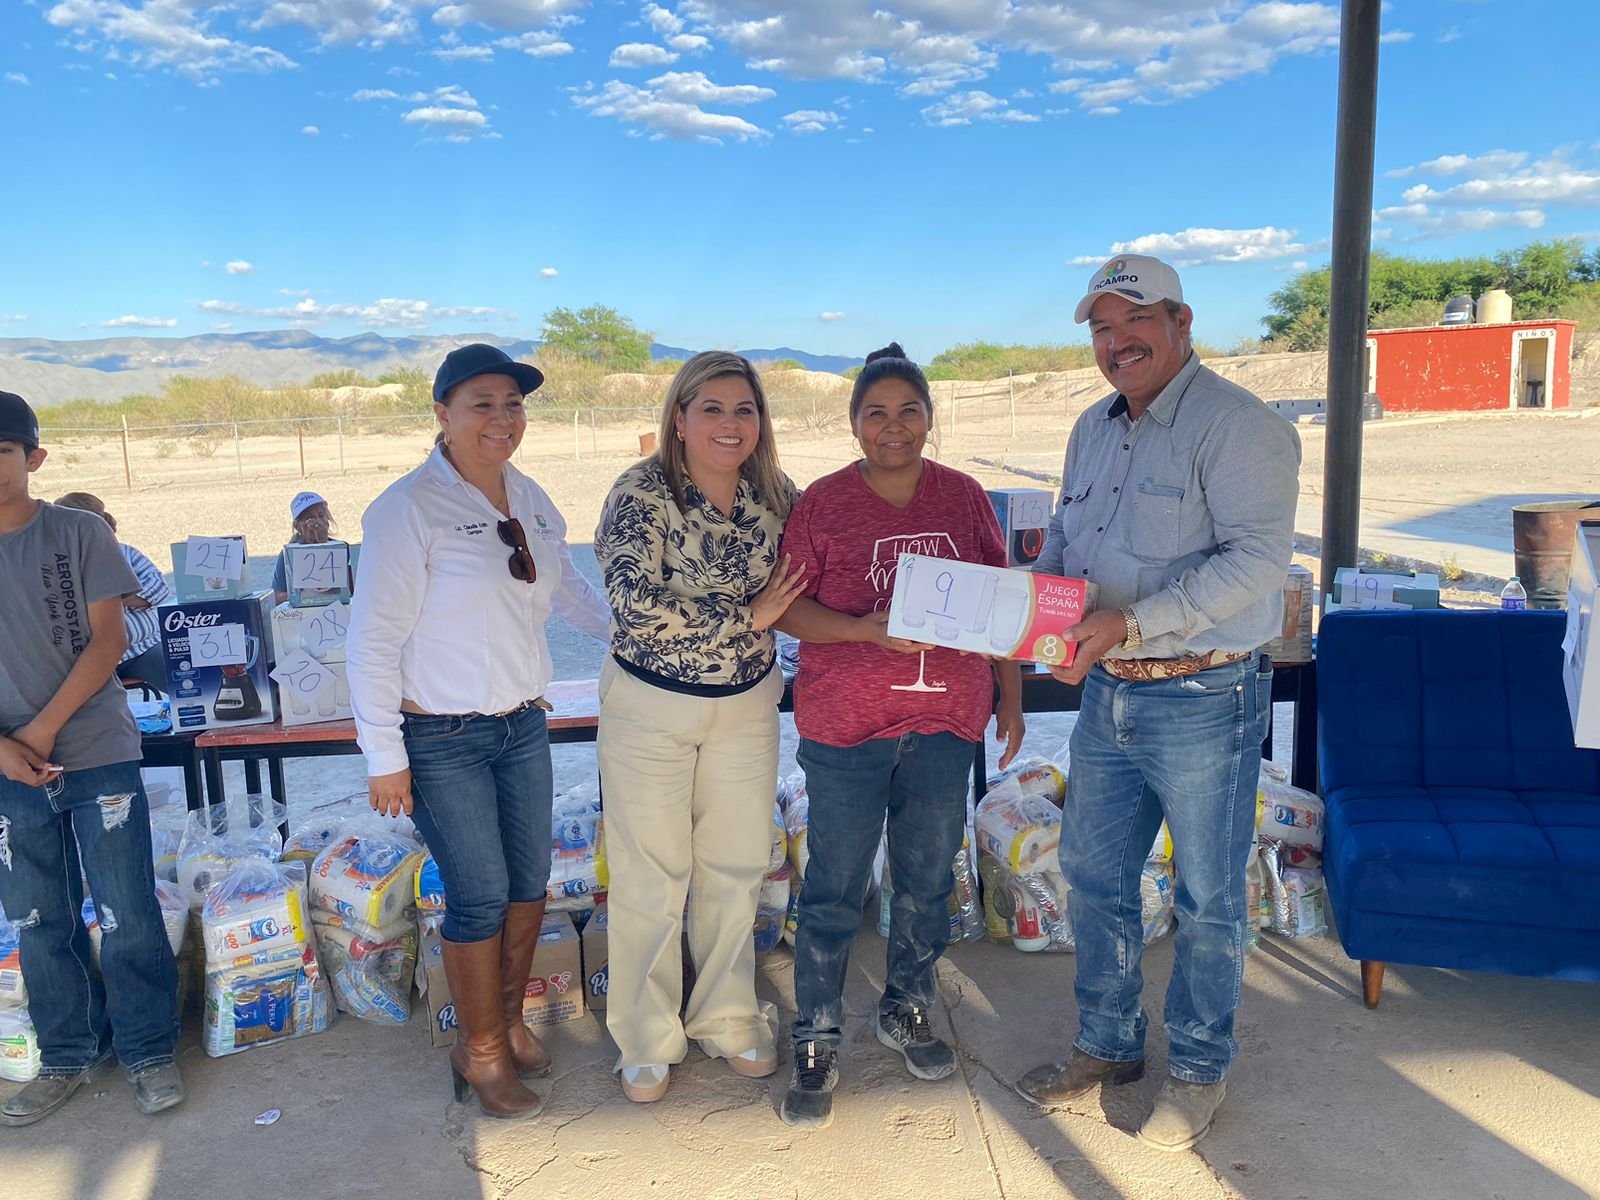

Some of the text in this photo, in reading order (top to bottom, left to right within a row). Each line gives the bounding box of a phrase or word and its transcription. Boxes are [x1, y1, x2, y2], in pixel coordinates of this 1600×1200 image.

[1093, 275, 1138, 291] OCAMPO
[1517, 329, 1554, 338] NIÑOS
[1018, 500, 1043, 524] 13
[196, 543, 232, 571] 27
[894, 537, 940, 559] HOW
[301, 551, 342, 583] 24
[936, 572, 954, 612] 9
[1038, 593, 1079, 610] ESPAÑA
[1043, 583, 1079, 598] JUEGO
[1352, 577, 1379, 604] 19
[54, 553, 83, 654] AEROPOSTALE
[164, 610, 222, 632] Oster
[310, 609, 347, 646] 28
[198, 629, 240, 659] 31
[1043, 636, 1057, 657] 8
